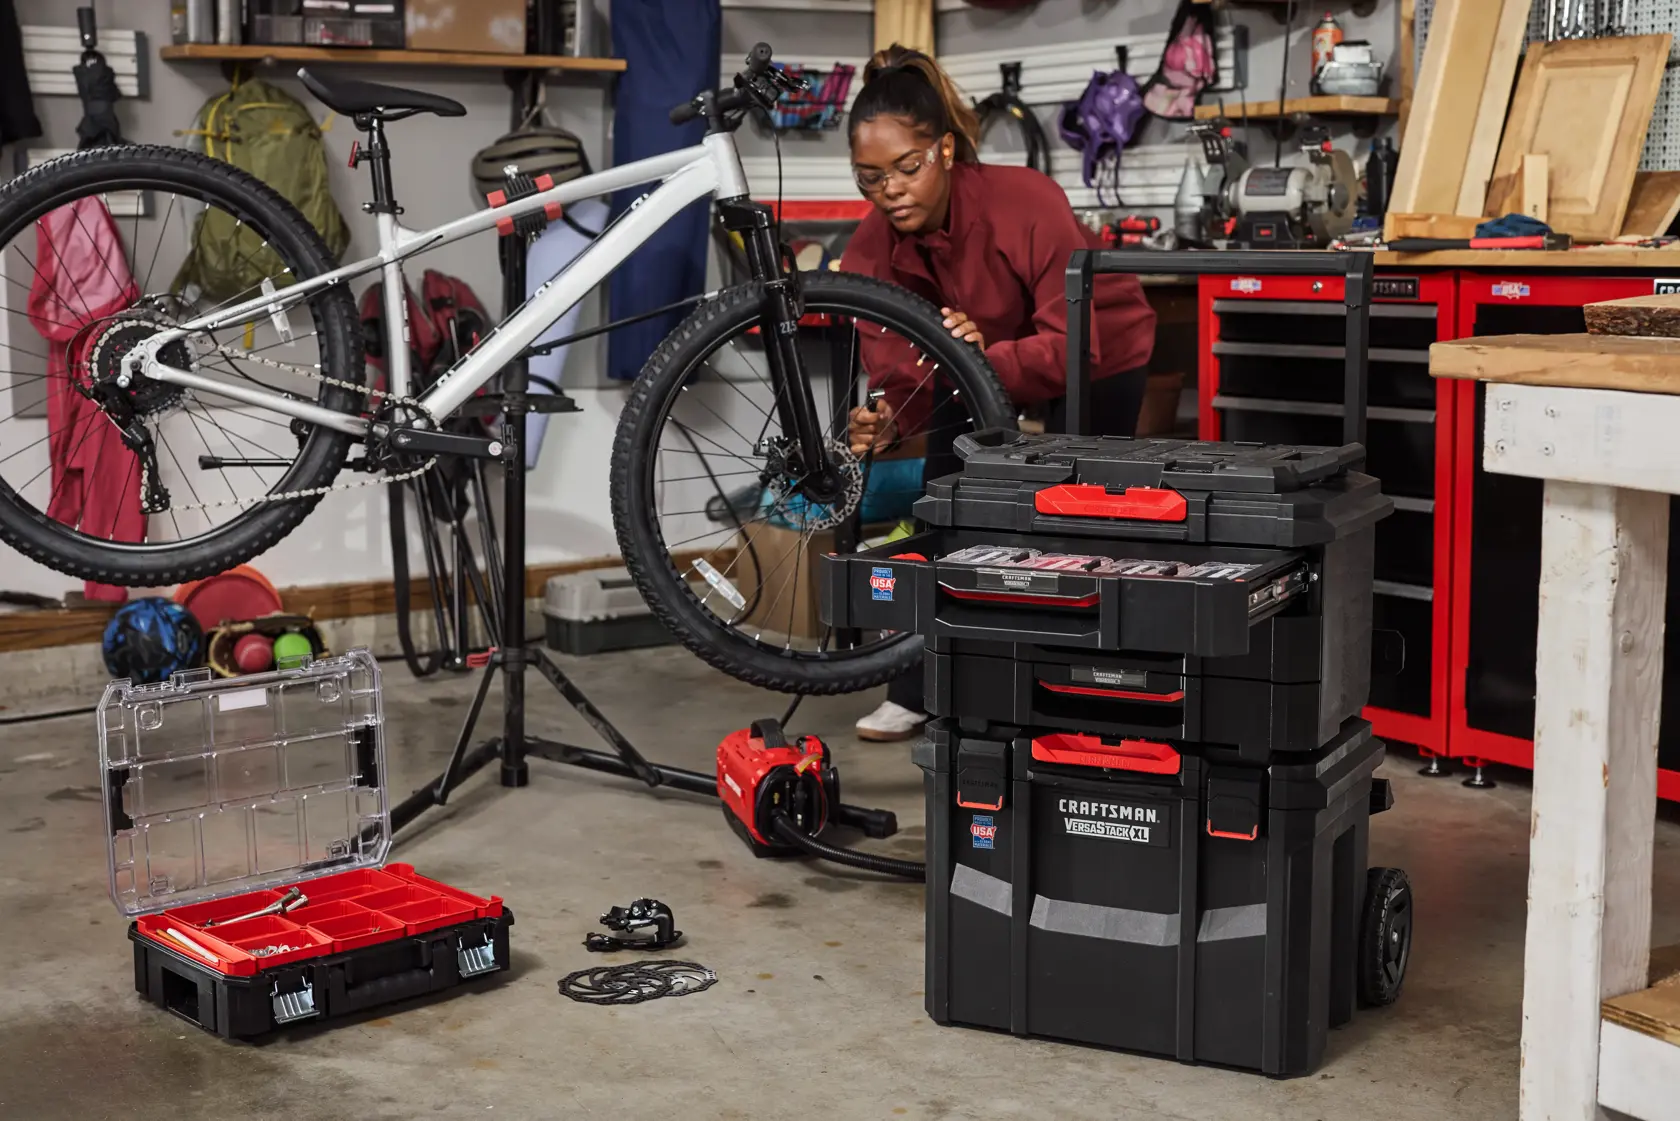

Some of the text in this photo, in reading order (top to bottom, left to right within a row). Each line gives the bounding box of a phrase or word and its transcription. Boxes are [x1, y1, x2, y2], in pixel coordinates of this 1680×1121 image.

[873, 578, 892, 588] USA
[1059, 799, 1157, 823] CRAFTSMAN
[973, 826, 993, 836] USA
[1132, 827, 1148, 841] XL
